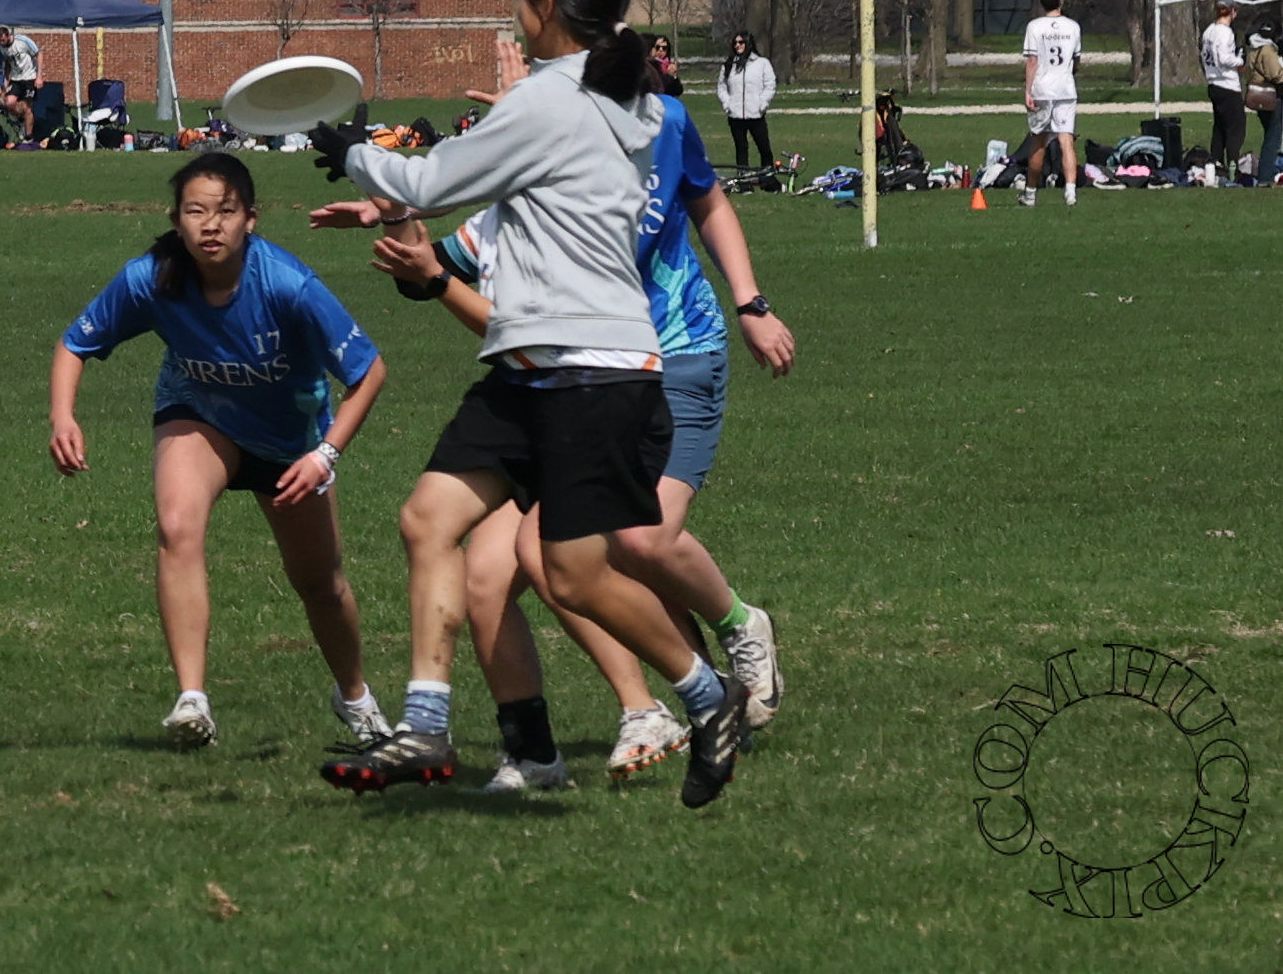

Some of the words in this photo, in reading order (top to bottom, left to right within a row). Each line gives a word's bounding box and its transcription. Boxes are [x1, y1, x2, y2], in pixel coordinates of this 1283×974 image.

[1049, 46, 1064, 66] 3
[253, 330, 281, 356] 17
[174, 354, 292, 387] SIRENS
